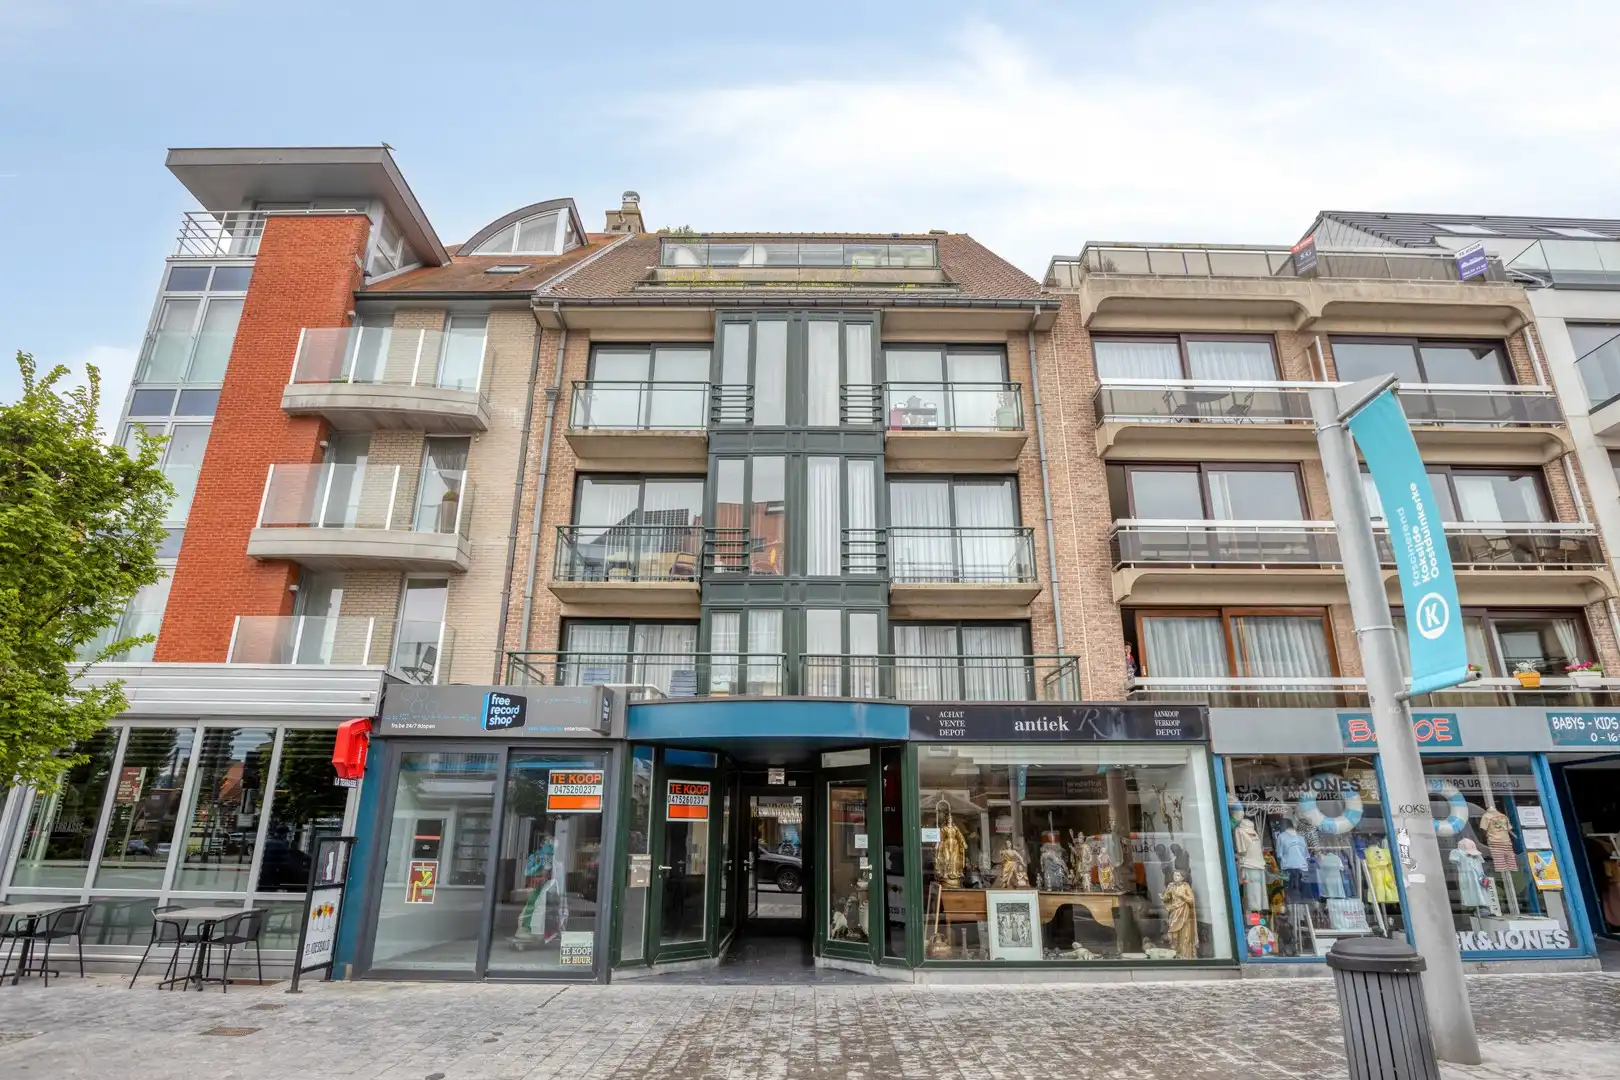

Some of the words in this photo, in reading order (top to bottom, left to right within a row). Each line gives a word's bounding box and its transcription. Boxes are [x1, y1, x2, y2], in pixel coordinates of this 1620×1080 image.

[1409, 482, 1439, 580] Oostduinkerke
[1396, 506, 1421, 587] Fascinerend
[1411, 525, 1430, 583] Koksijde
[491, 694, 511, 706] free
[490, 705, 520, 715] record
[1154, 710, 1180, 718] AANKOOP
[489, 715, 513, 727] shop
[1014, 716, 1070, 732] antiek
[1154, 719, 1181, 727] VERKOOP
[1552, 716, 1586, 730] BABYS
[1593, 716, 1619, 730] KIDS
[940, 729, 966, 737] DEPOT
[1155, 728, 1182, 736] DEPOT
[1348, 718, 1453, 743] BOE
[1607, 732, 1620, 743] 16
[552, 773, 567, 784] TE
[568, 773, 602, 784] KOOP
[554, 785, 597, 794] 0475260237
[670, 784, 682, 793] TE
[683, 784, 709, 795] KOOP
[667, 795, 705, 804] 0475260237
[1456, 929, 1570, 951] K&JONES
[562, 947, 571, 955] TE
[571, 947, 592, 955] KOOP
[561, 956, 571, 964] TE
[571, 956, 591, 964] HUUR
